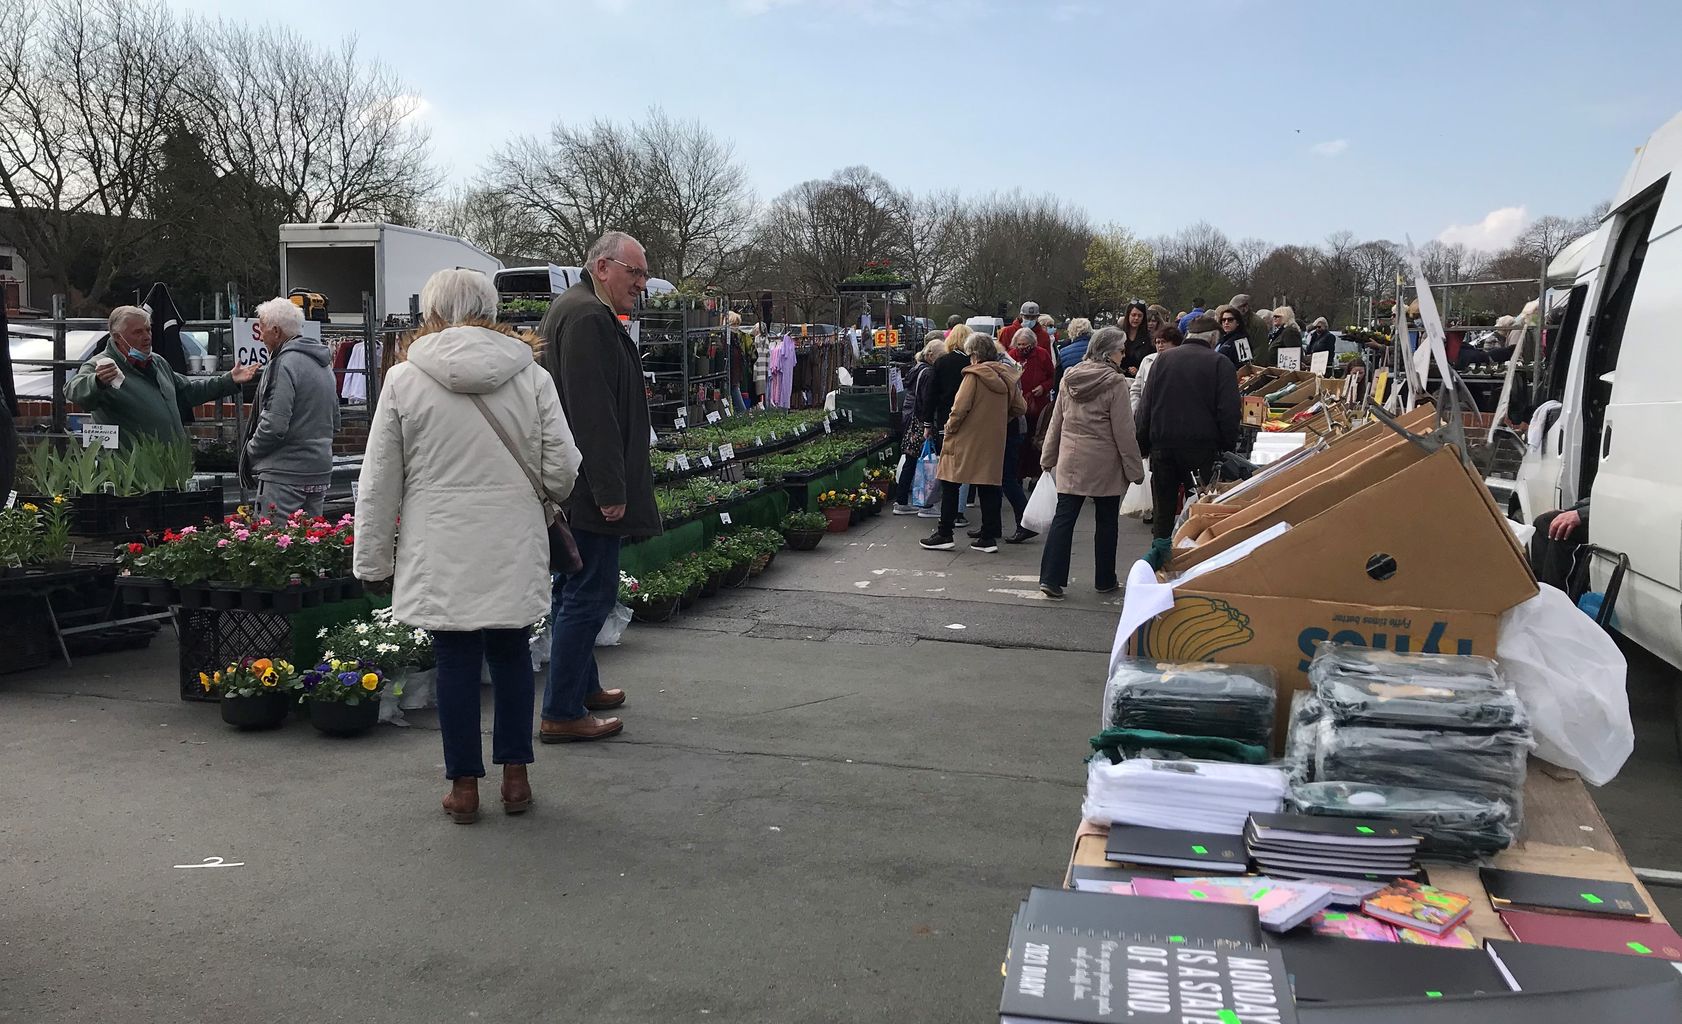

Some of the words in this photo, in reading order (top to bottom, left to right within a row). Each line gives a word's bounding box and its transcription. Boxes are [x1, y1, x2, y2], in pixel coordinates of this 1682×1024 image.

[238, 347, 268, 366] CAS
[1127, 945, 1168, 967] OF
[1176, 948, 1219, 964] IS
[1177, 965, 1220, 977] A
[1126, 967, 1171, 1016] MIND.
[1227, 955, 1281, 1024] MONDAY
